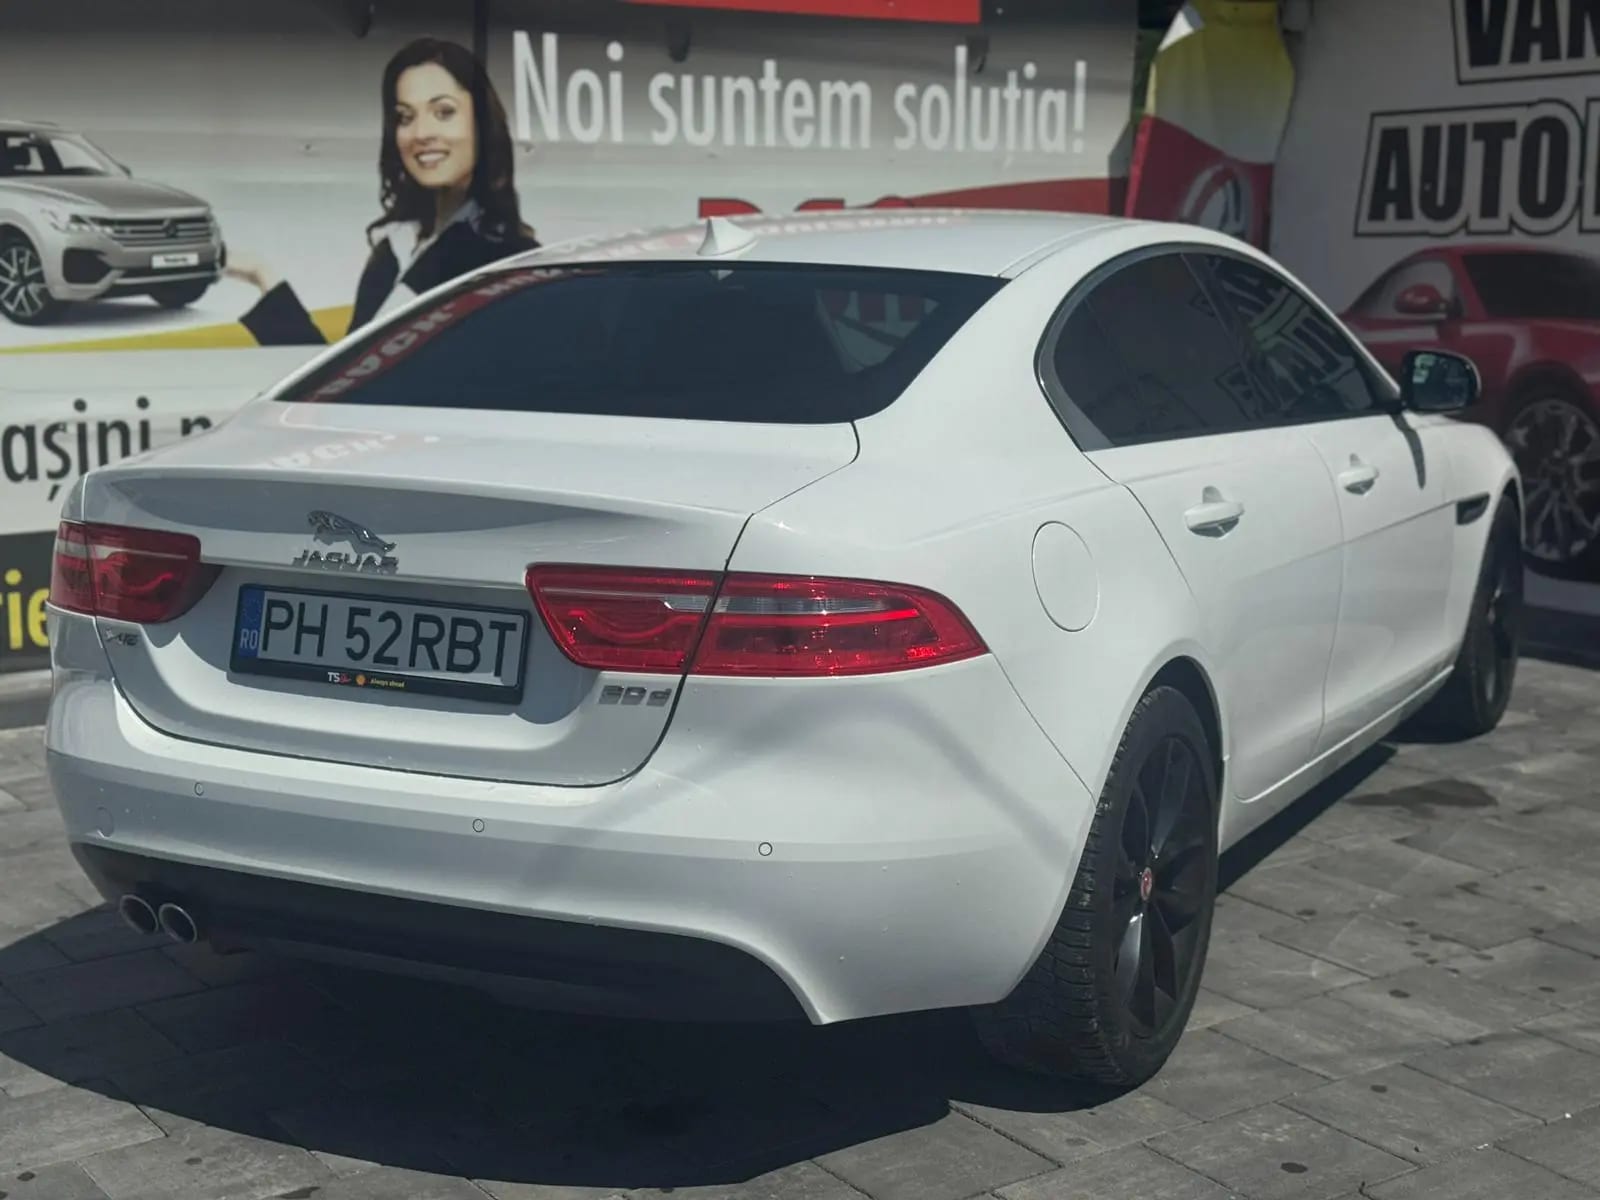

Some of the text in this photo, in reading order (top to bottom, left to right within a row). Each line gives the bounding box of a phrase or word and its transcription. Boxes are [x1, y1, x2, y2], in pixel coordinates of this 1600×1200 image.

[513, 30, 624, 143] Noi
[649, 59, 872, 148] suntem
[1367, 115, 1569, 222] AUTO
[291, 549, 399, 575] JAGUAR
[239, 629, 259, 649] RO
[262, 599, 328, 657] PH
